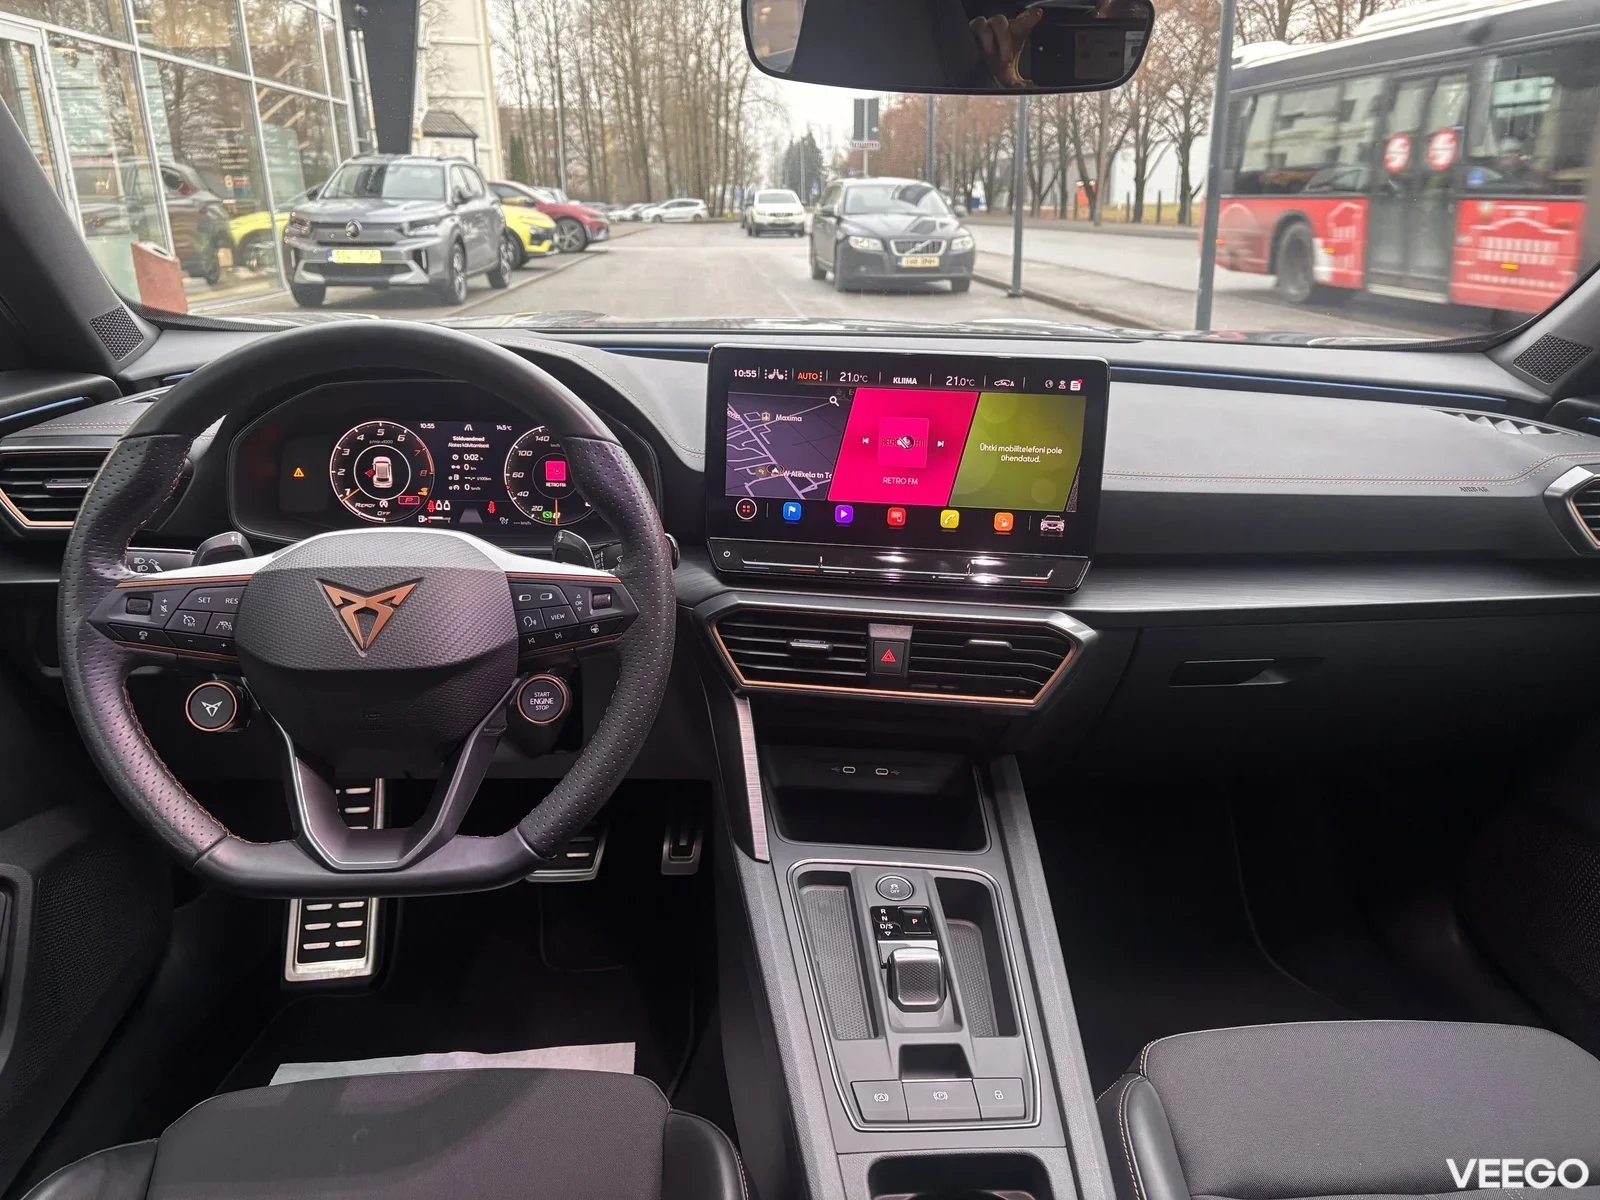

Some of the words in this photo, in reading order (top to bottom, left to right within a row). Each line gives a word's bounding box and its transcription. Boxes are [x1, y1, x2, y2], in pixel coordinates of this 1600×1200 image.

[733, 369, 757, 378] 10:55
[797, 372, 818, 380] AUTO
[893, 376, 918, 385] KLIIMA
[775, 414, 802, 422] Maxima
[376, 428, 385, 436] 5
[397, 434, 406, 442] 6
[341, 448, 350, 456] 3
[413, 449, 421, 457] 7
[998, 445, 1046, 454] mobiiltelefoni
[1046, 446, 1062, 455] pole
[463, 453, 479, 461] 0:02
[463, 463, 470, 471] 0
[337, 468, 346, 476] 2
[882, 476, 907, 485] RETRO
[907, 477, 919, 485] FM
[464, 483, 470, 491] 0
[344, 488, 351, 496] 1
[517, 490, 529, 498] 40
[198, 596, 212, 604] SET
[225, 597, 239, 605] RES
[550, 613, 566, 621] VIEW
[529, 697, 554, 705] ENGINE
